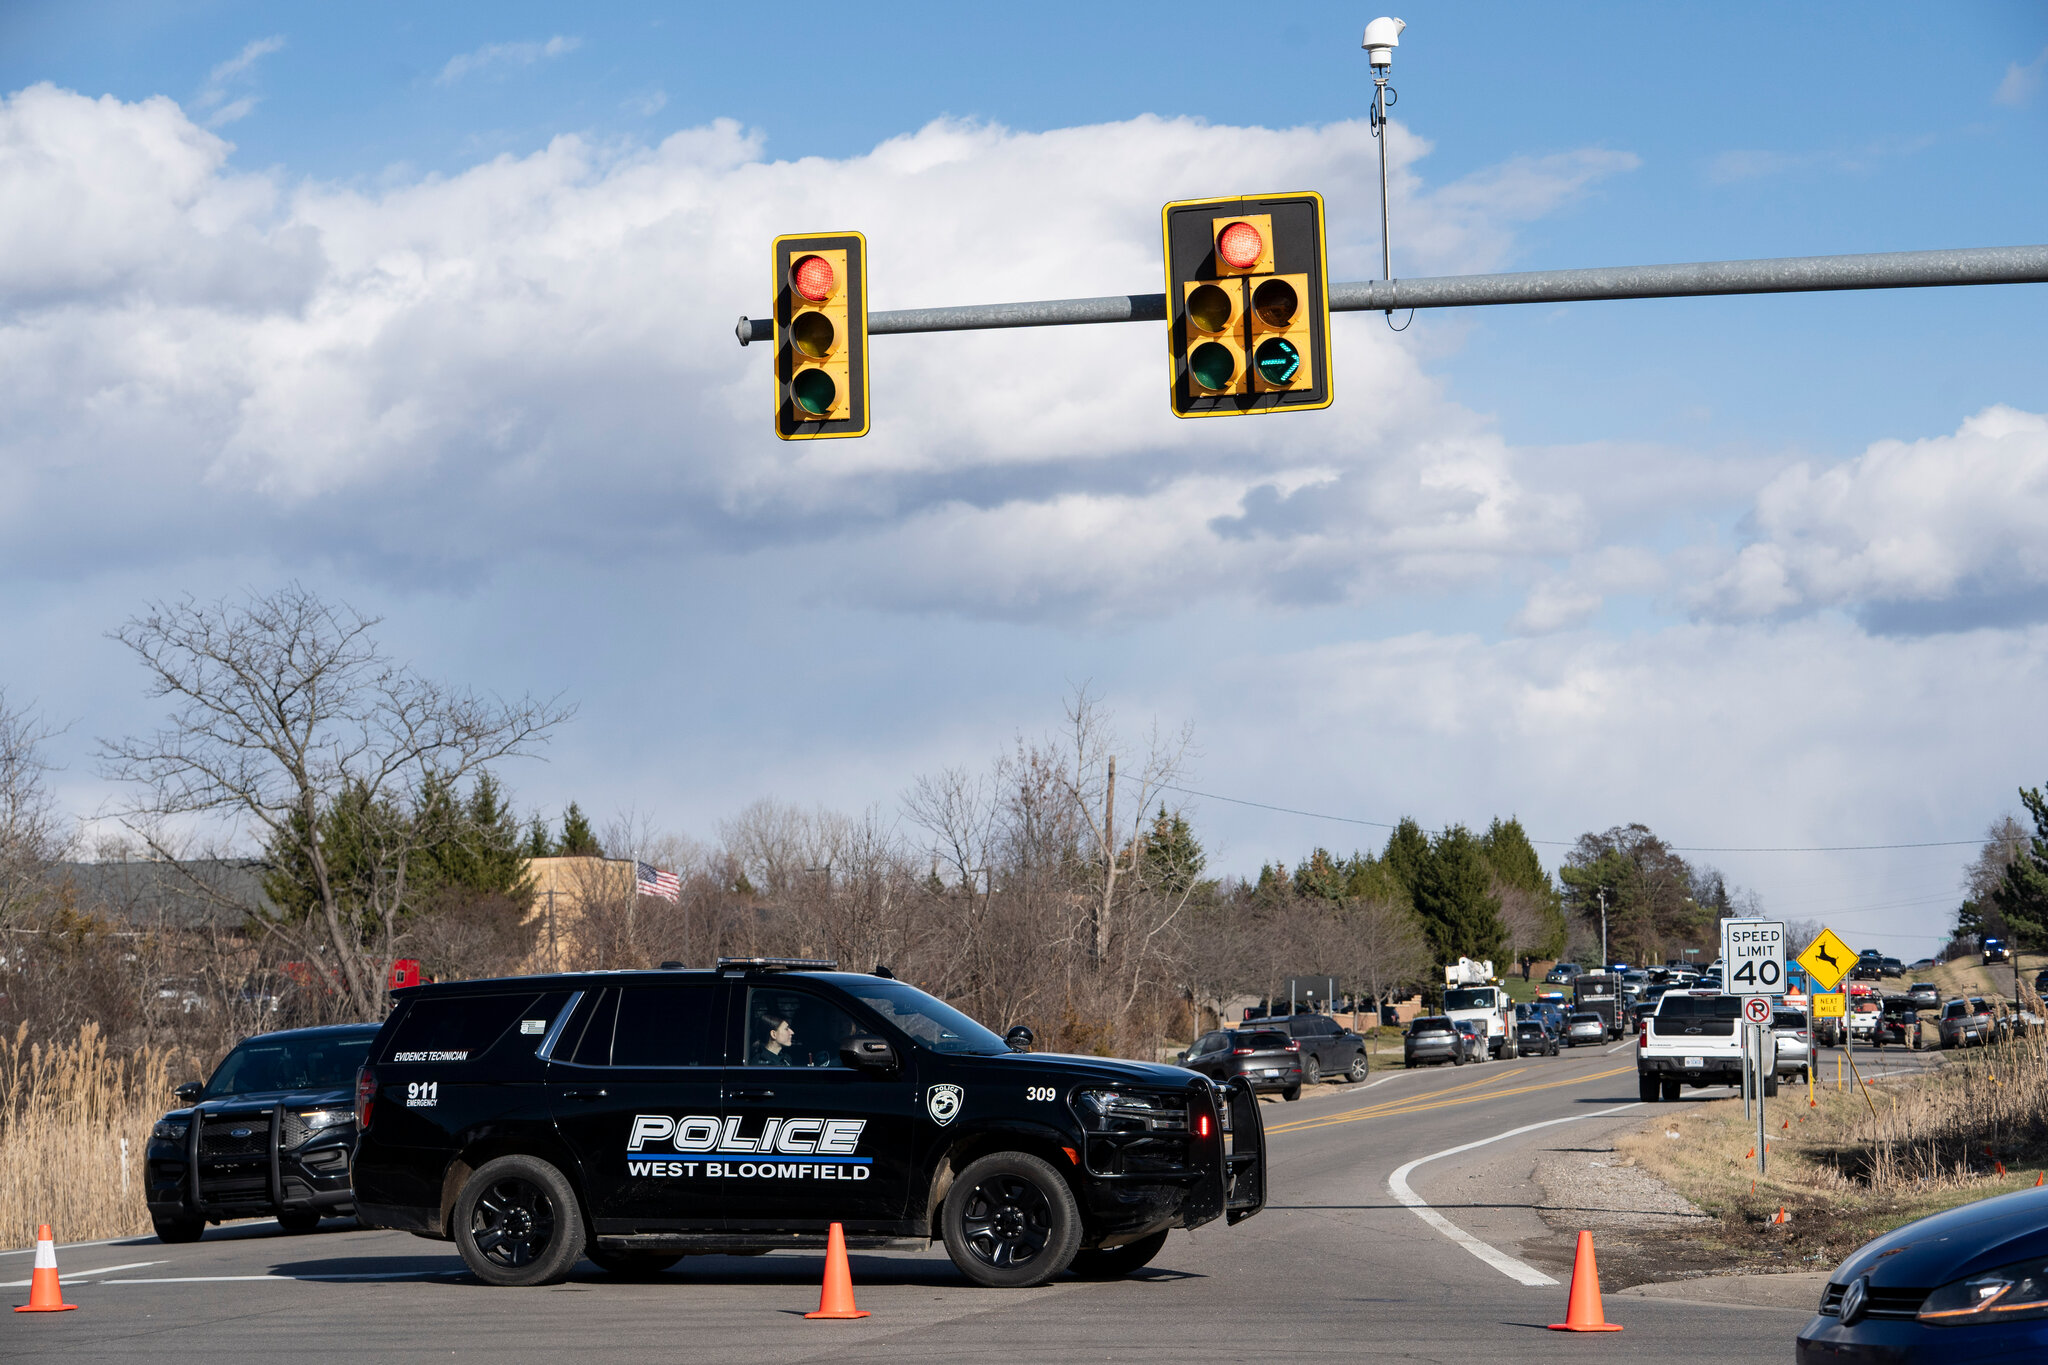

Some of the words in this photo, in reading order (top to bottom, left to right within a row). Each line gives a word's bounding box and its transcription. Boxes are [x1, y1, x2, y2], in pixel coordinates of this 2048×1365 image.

[1732, 931, 1780, 942] SPEED
[1738, 945, 1774, 957] LIMIT
[1733, 960, 1780, 986] 40
[1752, 1002, 1765, 1018] P
[394, 1052, 428, 1061] EVIDENCE
[428, 1051, 468, 1060] TECHNICIAN
[408, 1082, 438, 1099] 911
[934, 1085, 959, 1094] POLICE
[1026, 1086, 1056, 1101] 309
[406, 1099, 438, 1107] EMERGENCY
[626, 1114, 867, 1155] POLICE
[628, 1162, 699, 1177] WEST
[706, 1162, 870, 1180] BLOOMFIELD
